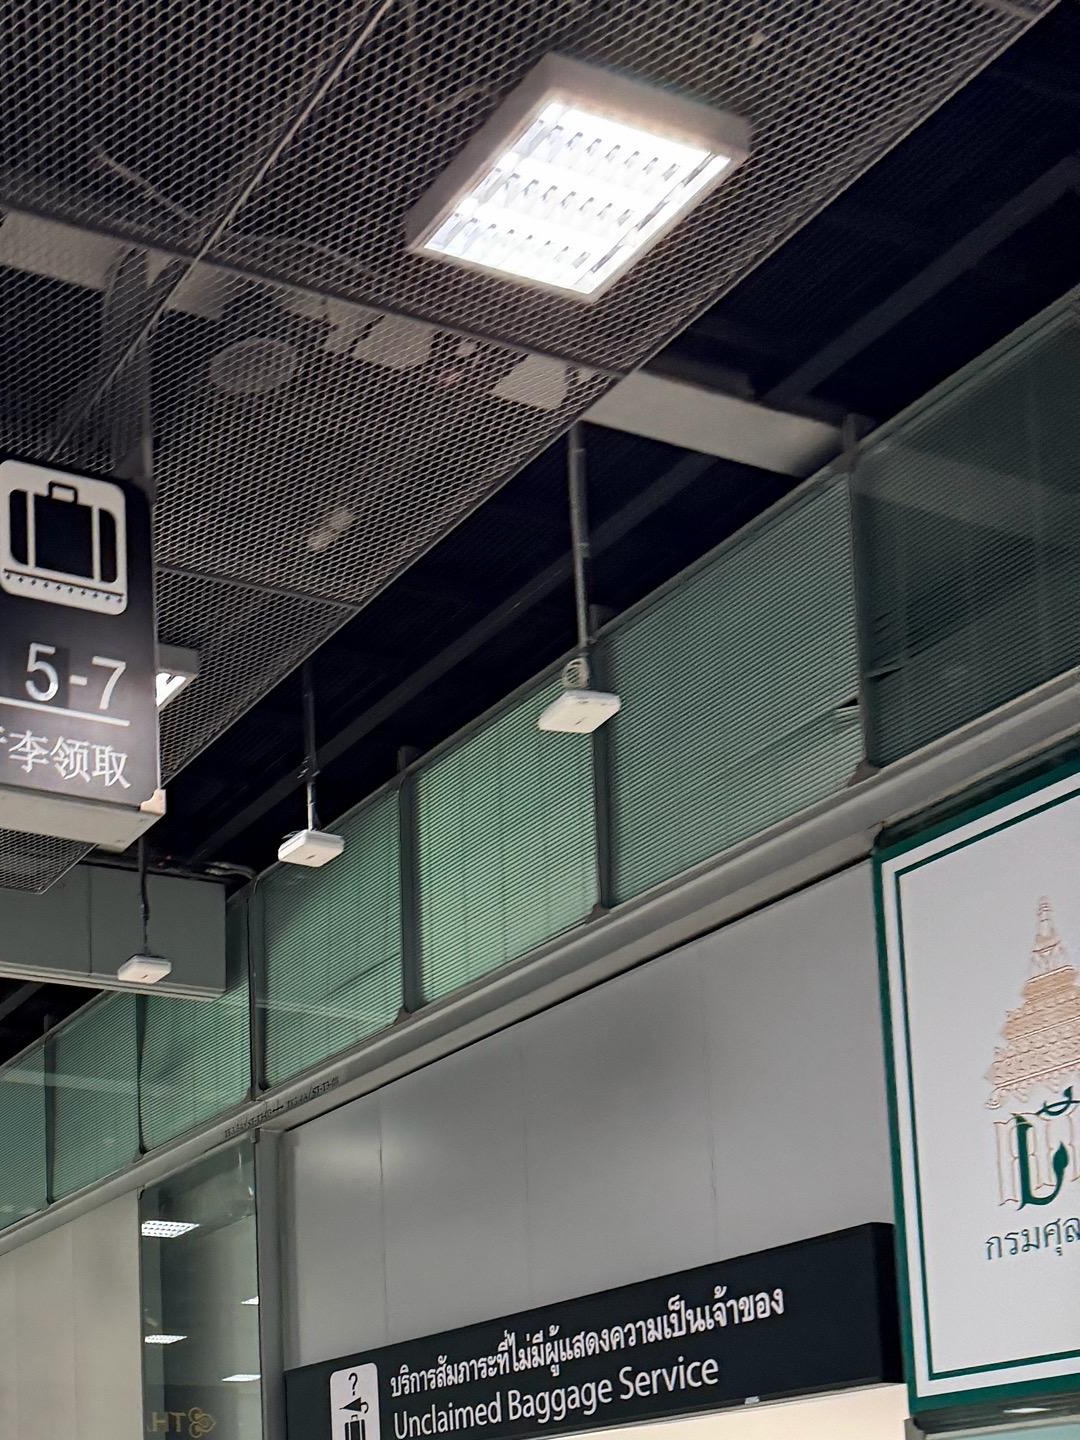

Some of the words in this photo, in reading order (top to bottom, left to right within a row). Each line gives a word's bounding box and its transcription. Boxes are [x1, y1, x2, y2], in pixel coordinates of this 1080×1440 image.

[25, 641, 127, 711] 5-7
[389, 1285, 785, 1398] บริการสัมภาระที่ไม่มีผู้แสดงความเป็นเจ้าของ
[394, 1399, 502, 1440] Unclaimed
[508, 1376, 613, 1430] Baggage
[620, 1354, 720, 1395] Service
